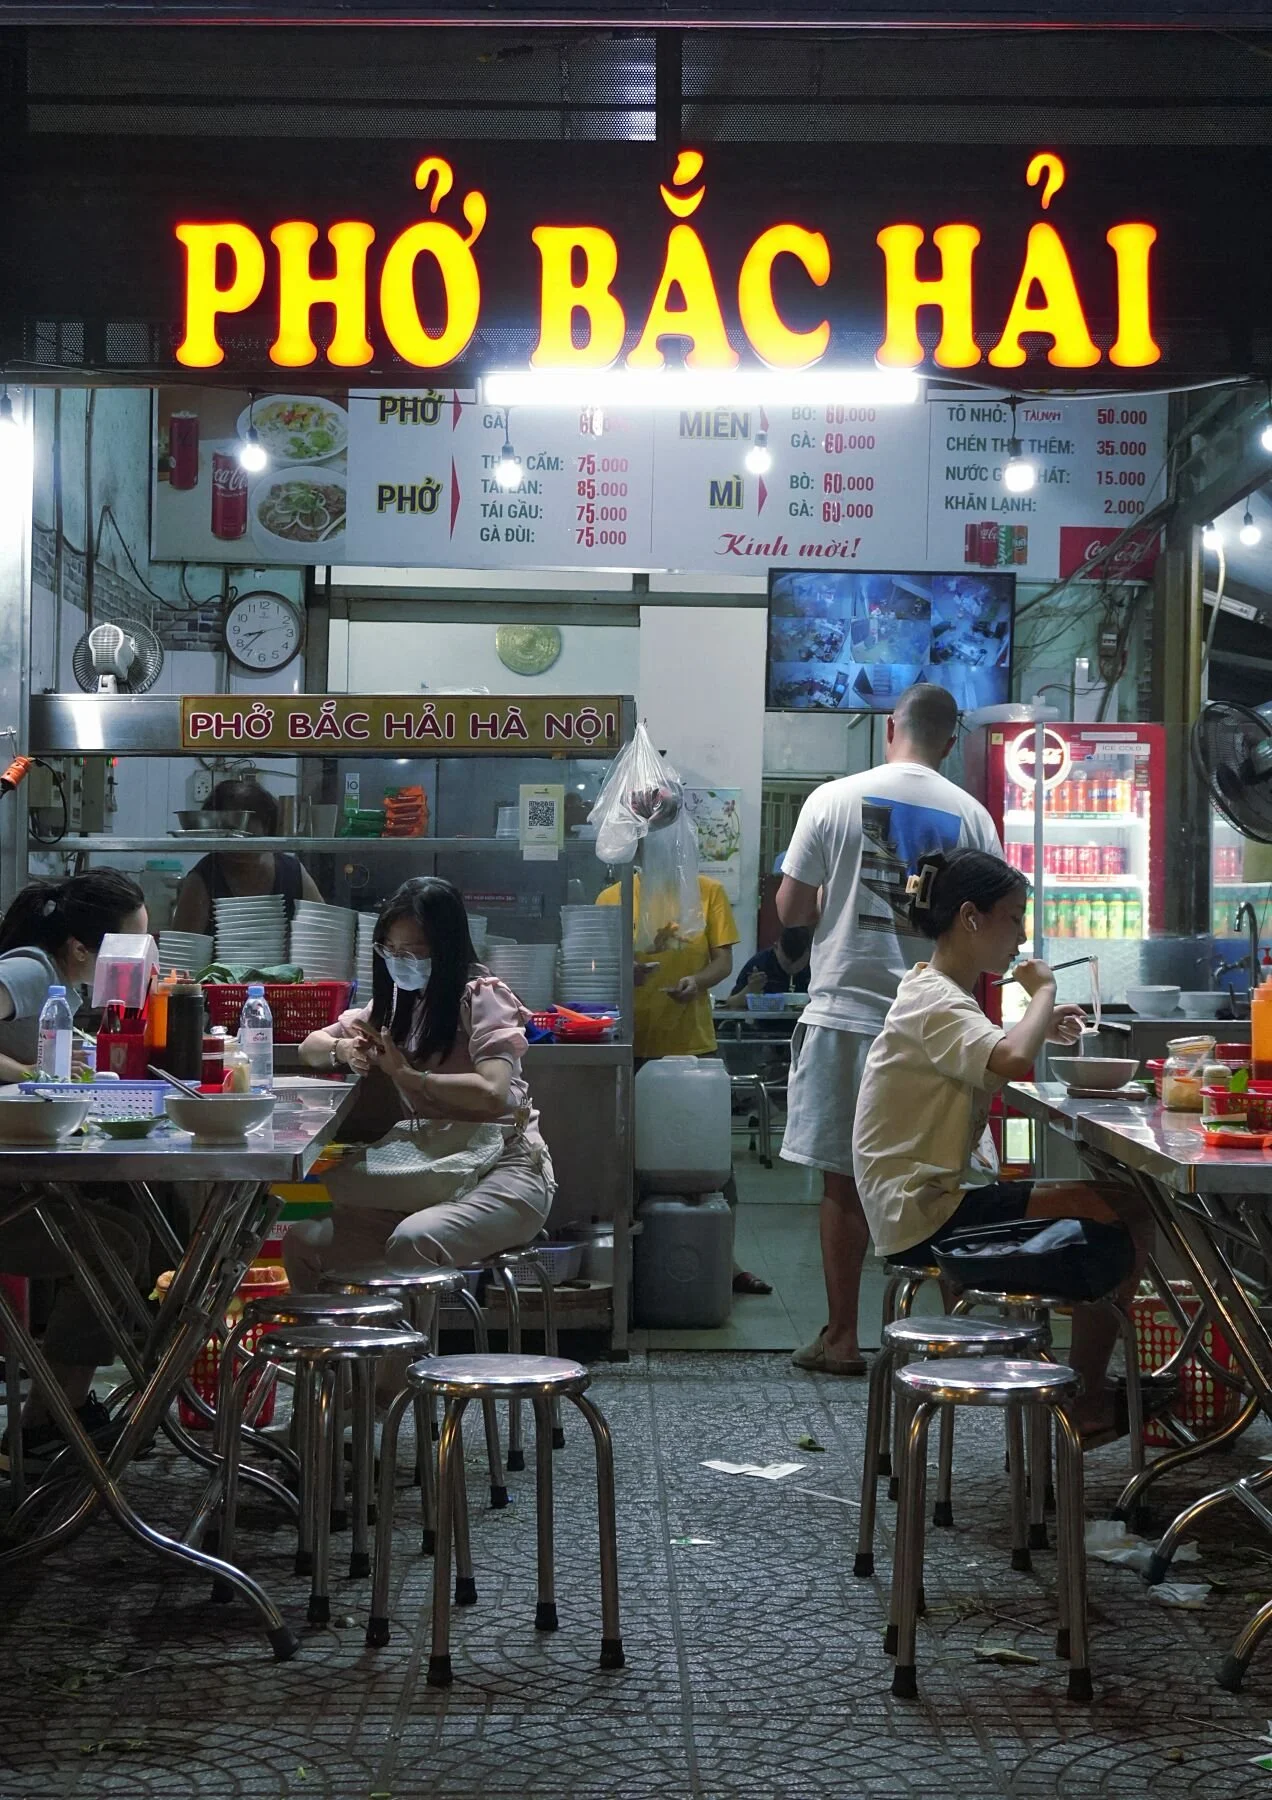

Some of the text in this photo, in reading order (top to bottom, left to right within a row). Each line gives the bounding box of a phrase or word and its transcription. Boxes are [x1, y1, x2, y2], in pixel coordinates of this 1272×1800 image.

[175, 151, 1161, 370] PHỞ BẮC HẢI
[379, 389, 445, 425] PHỞ
[825, 404, 876, 425] 60.000
[947, 404, 1007, 423] TÔ NHỎ:
[1097, 408, 1148, 425] 50.000
[790, 431, 875, 454] GÀ: 60.000
[946, 434, 987, 451] CHÉN
[1027, 436, 1075, 455] THÊM:
[1096, 440, 1147, 456] 35.000
[577, 454, 628, 475] 75.000
[945, 464, 989, 482] NƯỚC
[789, 472, 874, 494] BÒ: 60.000
[1034, 466, 1070, 484] HÁT:
[1096, 471, 1146, 486] 15.000
[377, 476, 443, 515] PHỞ
[577, 479, 628, 500] 85.000
[708, 474, 744, 509] MÌ
[480, 499, 627, 524] TÁI GẦU: 75.000
[789, 499, 874, 523] GÀ: 60.000
[944, 492, 1145, 515] KHĂN LẠNH: 2.000
[479, 524, 627, 547] GÀ ĐÙI: 75.000
[714, 533, 862, 558] Kính mời!
[248, 604, 256, 613] 11
[259, 601, 270, 610] 12
[238, 614, 248, 623] 10
[282, 616, 291, 625] 2
[232, 626, 241, 635] 9
[286, 629, 294, 638] 3
[271, 650, 280, 659] 5
[281, 641, 289, 650] 4
[258, 653, 266, 662] 6
[189, 700, 614, 746] PHỞ BẮC HẢI HÀ NỘI
